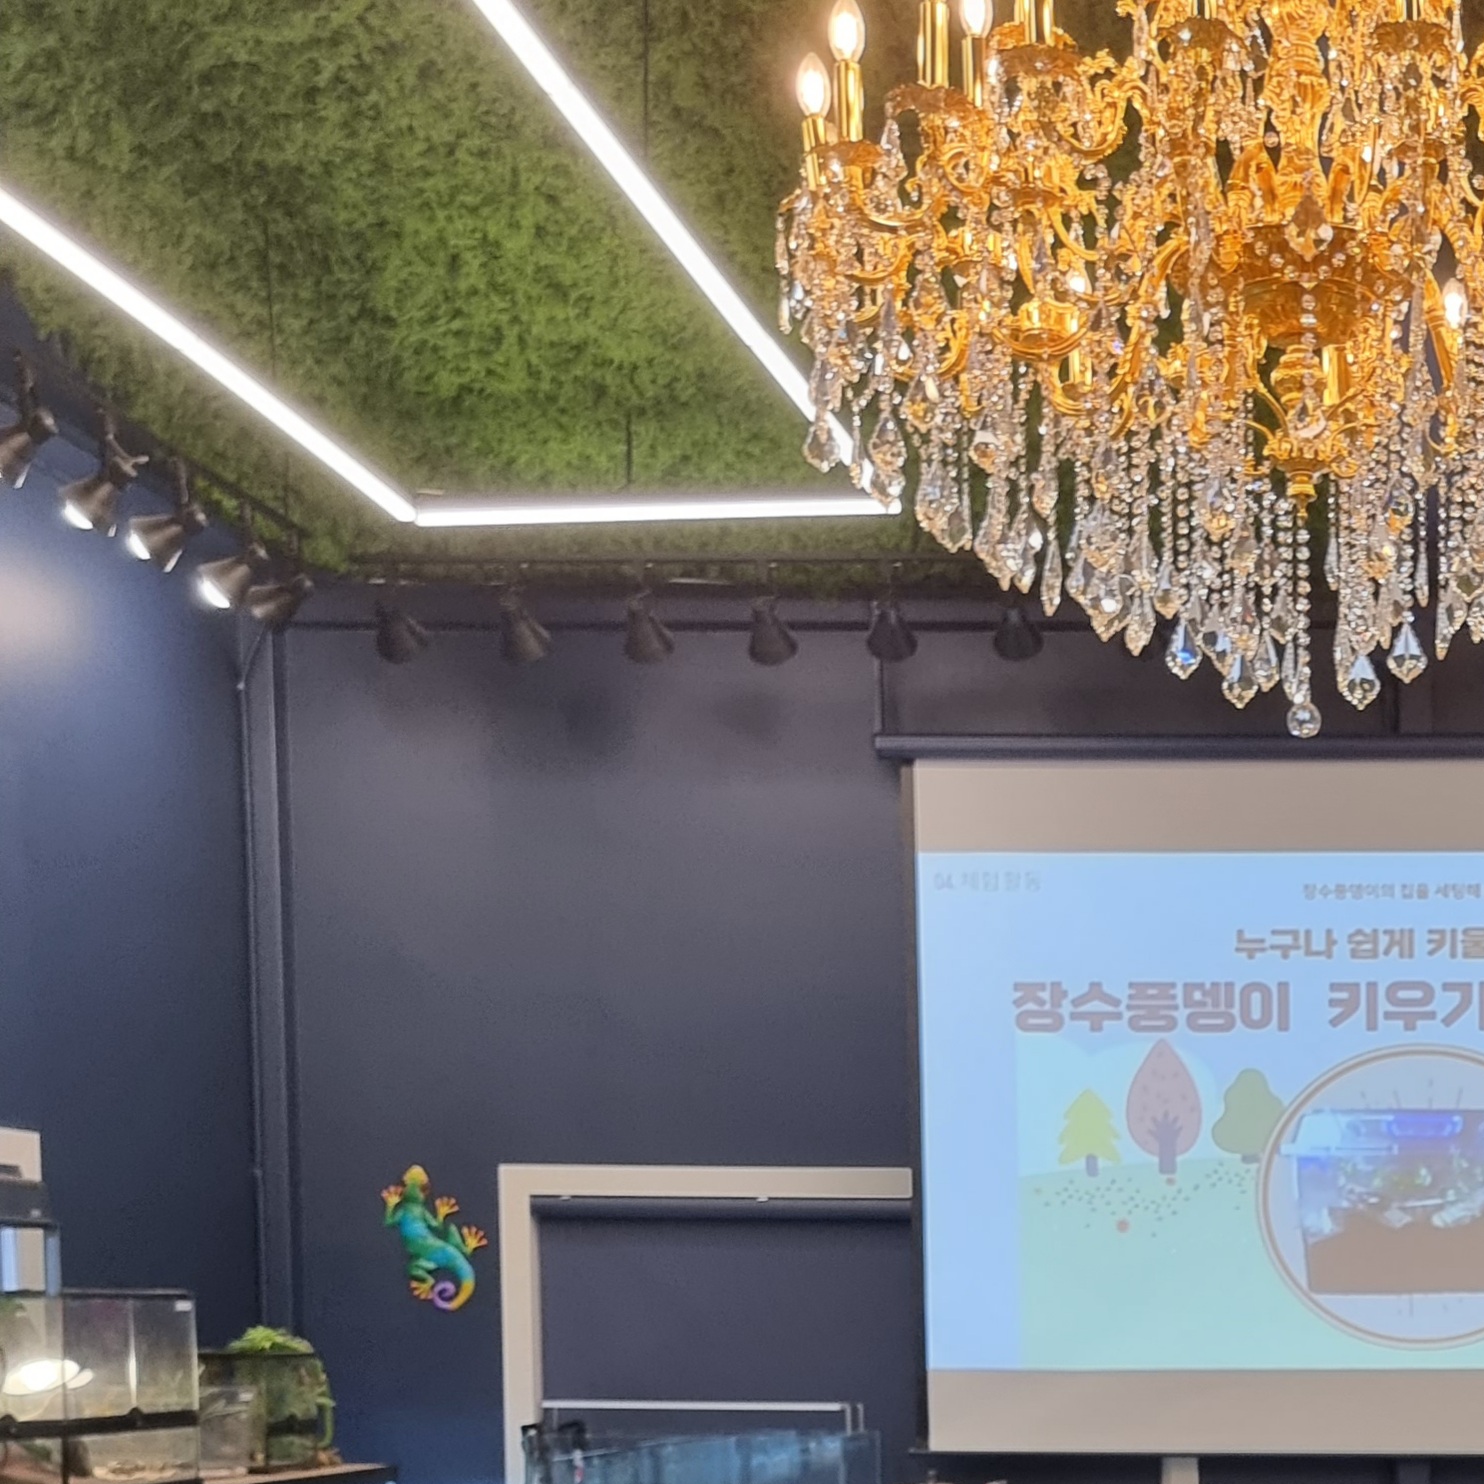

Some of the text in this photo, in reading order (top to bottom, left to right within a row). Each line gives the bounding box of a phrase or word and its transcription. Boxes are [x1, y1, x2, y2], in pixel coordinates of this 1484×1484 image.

[1303, 882, 1396, 900] 장수풍뎅이의
[1401, 883, 1430, 899] 집을
[1435, 882, 1482, 900] 세팅해
[1235, 927, 1337, 962] 누구나
[1347, 926, 1416, 961] 쉽게
[1011, 978, 1292, 1034] 장수풍뎅이
